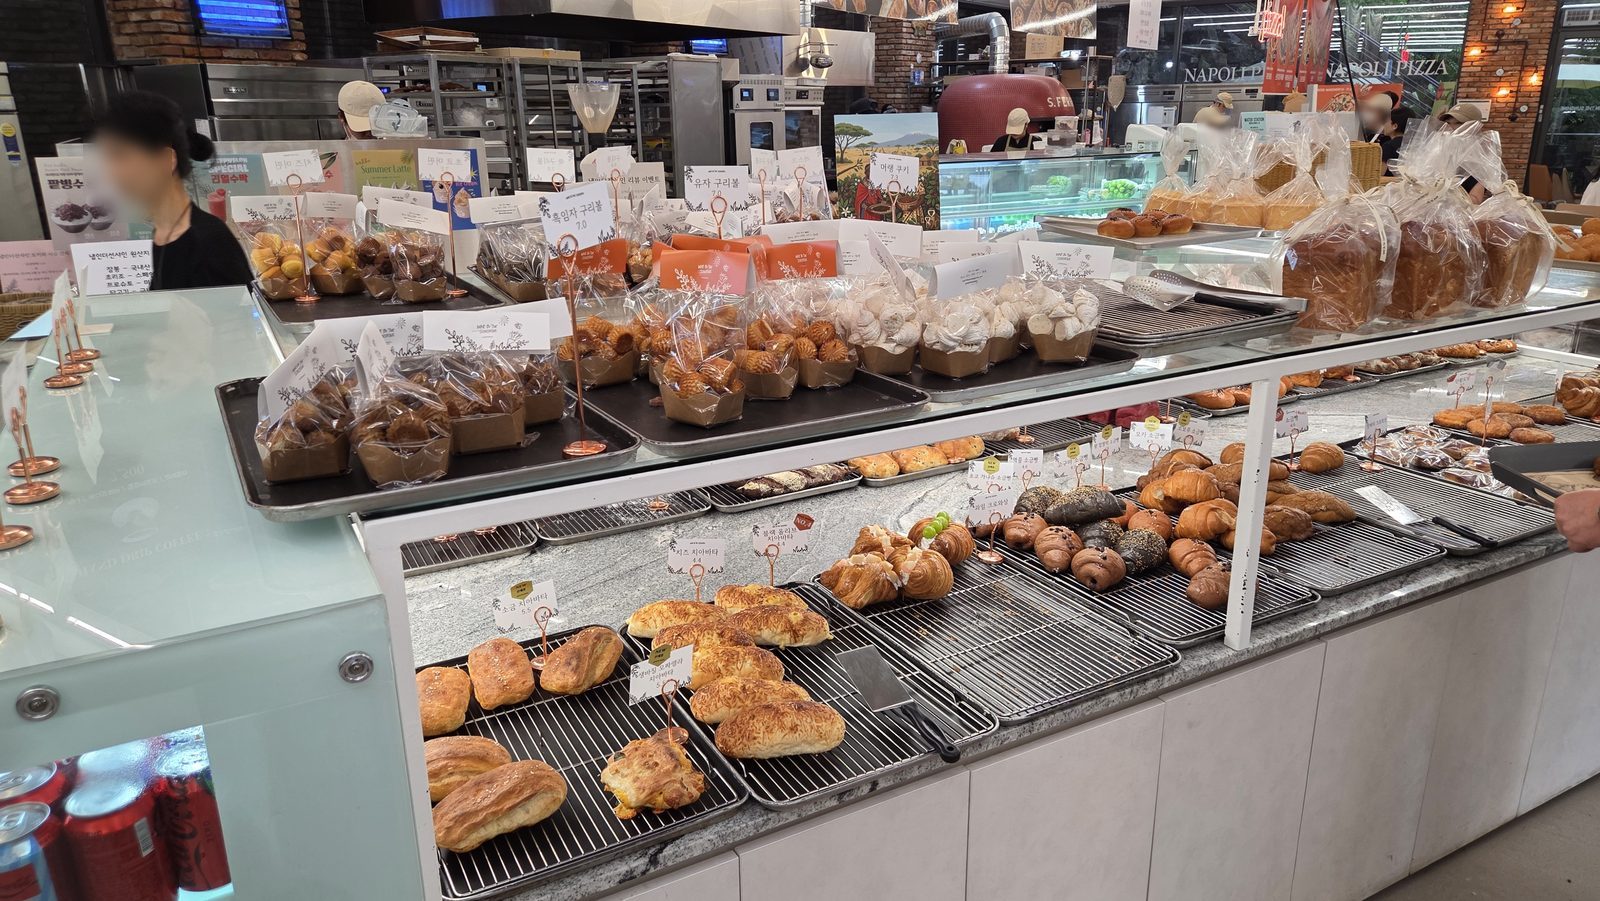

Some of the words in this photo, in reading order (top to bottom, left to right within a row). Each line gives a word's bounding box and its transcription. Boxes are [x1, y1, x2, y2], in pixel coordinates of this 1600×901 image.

[1396, 59, 1448, 76] PIZZA
[1184, 66, 1247, 83] NAPOLI
[361, 165, 392, 174] Summer
[393, 165, 411, 173] Latte
[880, 163, 894, 173] 머랭
[47, 179, 84, 190] 팥빙수
[641, 176, 660, 184] 이벤트
[694, 178, 711, 189] 유자
[714, 177, 740, 189] 구리볼
[552, 207, 578, 224] 흑임자
[580, 200, 603, 216] 구리볼
[576, 220, 587, 231] 7.0
[130, 250, 150, 258] 원산지
[763, 529, 776, 537] 블랙
[778, 527, 798, 535] 올리브
[768, 533, 794, 541] 치아바타
[676, 549, 689, 557] 치즈
[691, 548, 719, 556] 치아바타
[501, 603, 516, 614] 소금
[518, 593, 548, 607] 치아바타
